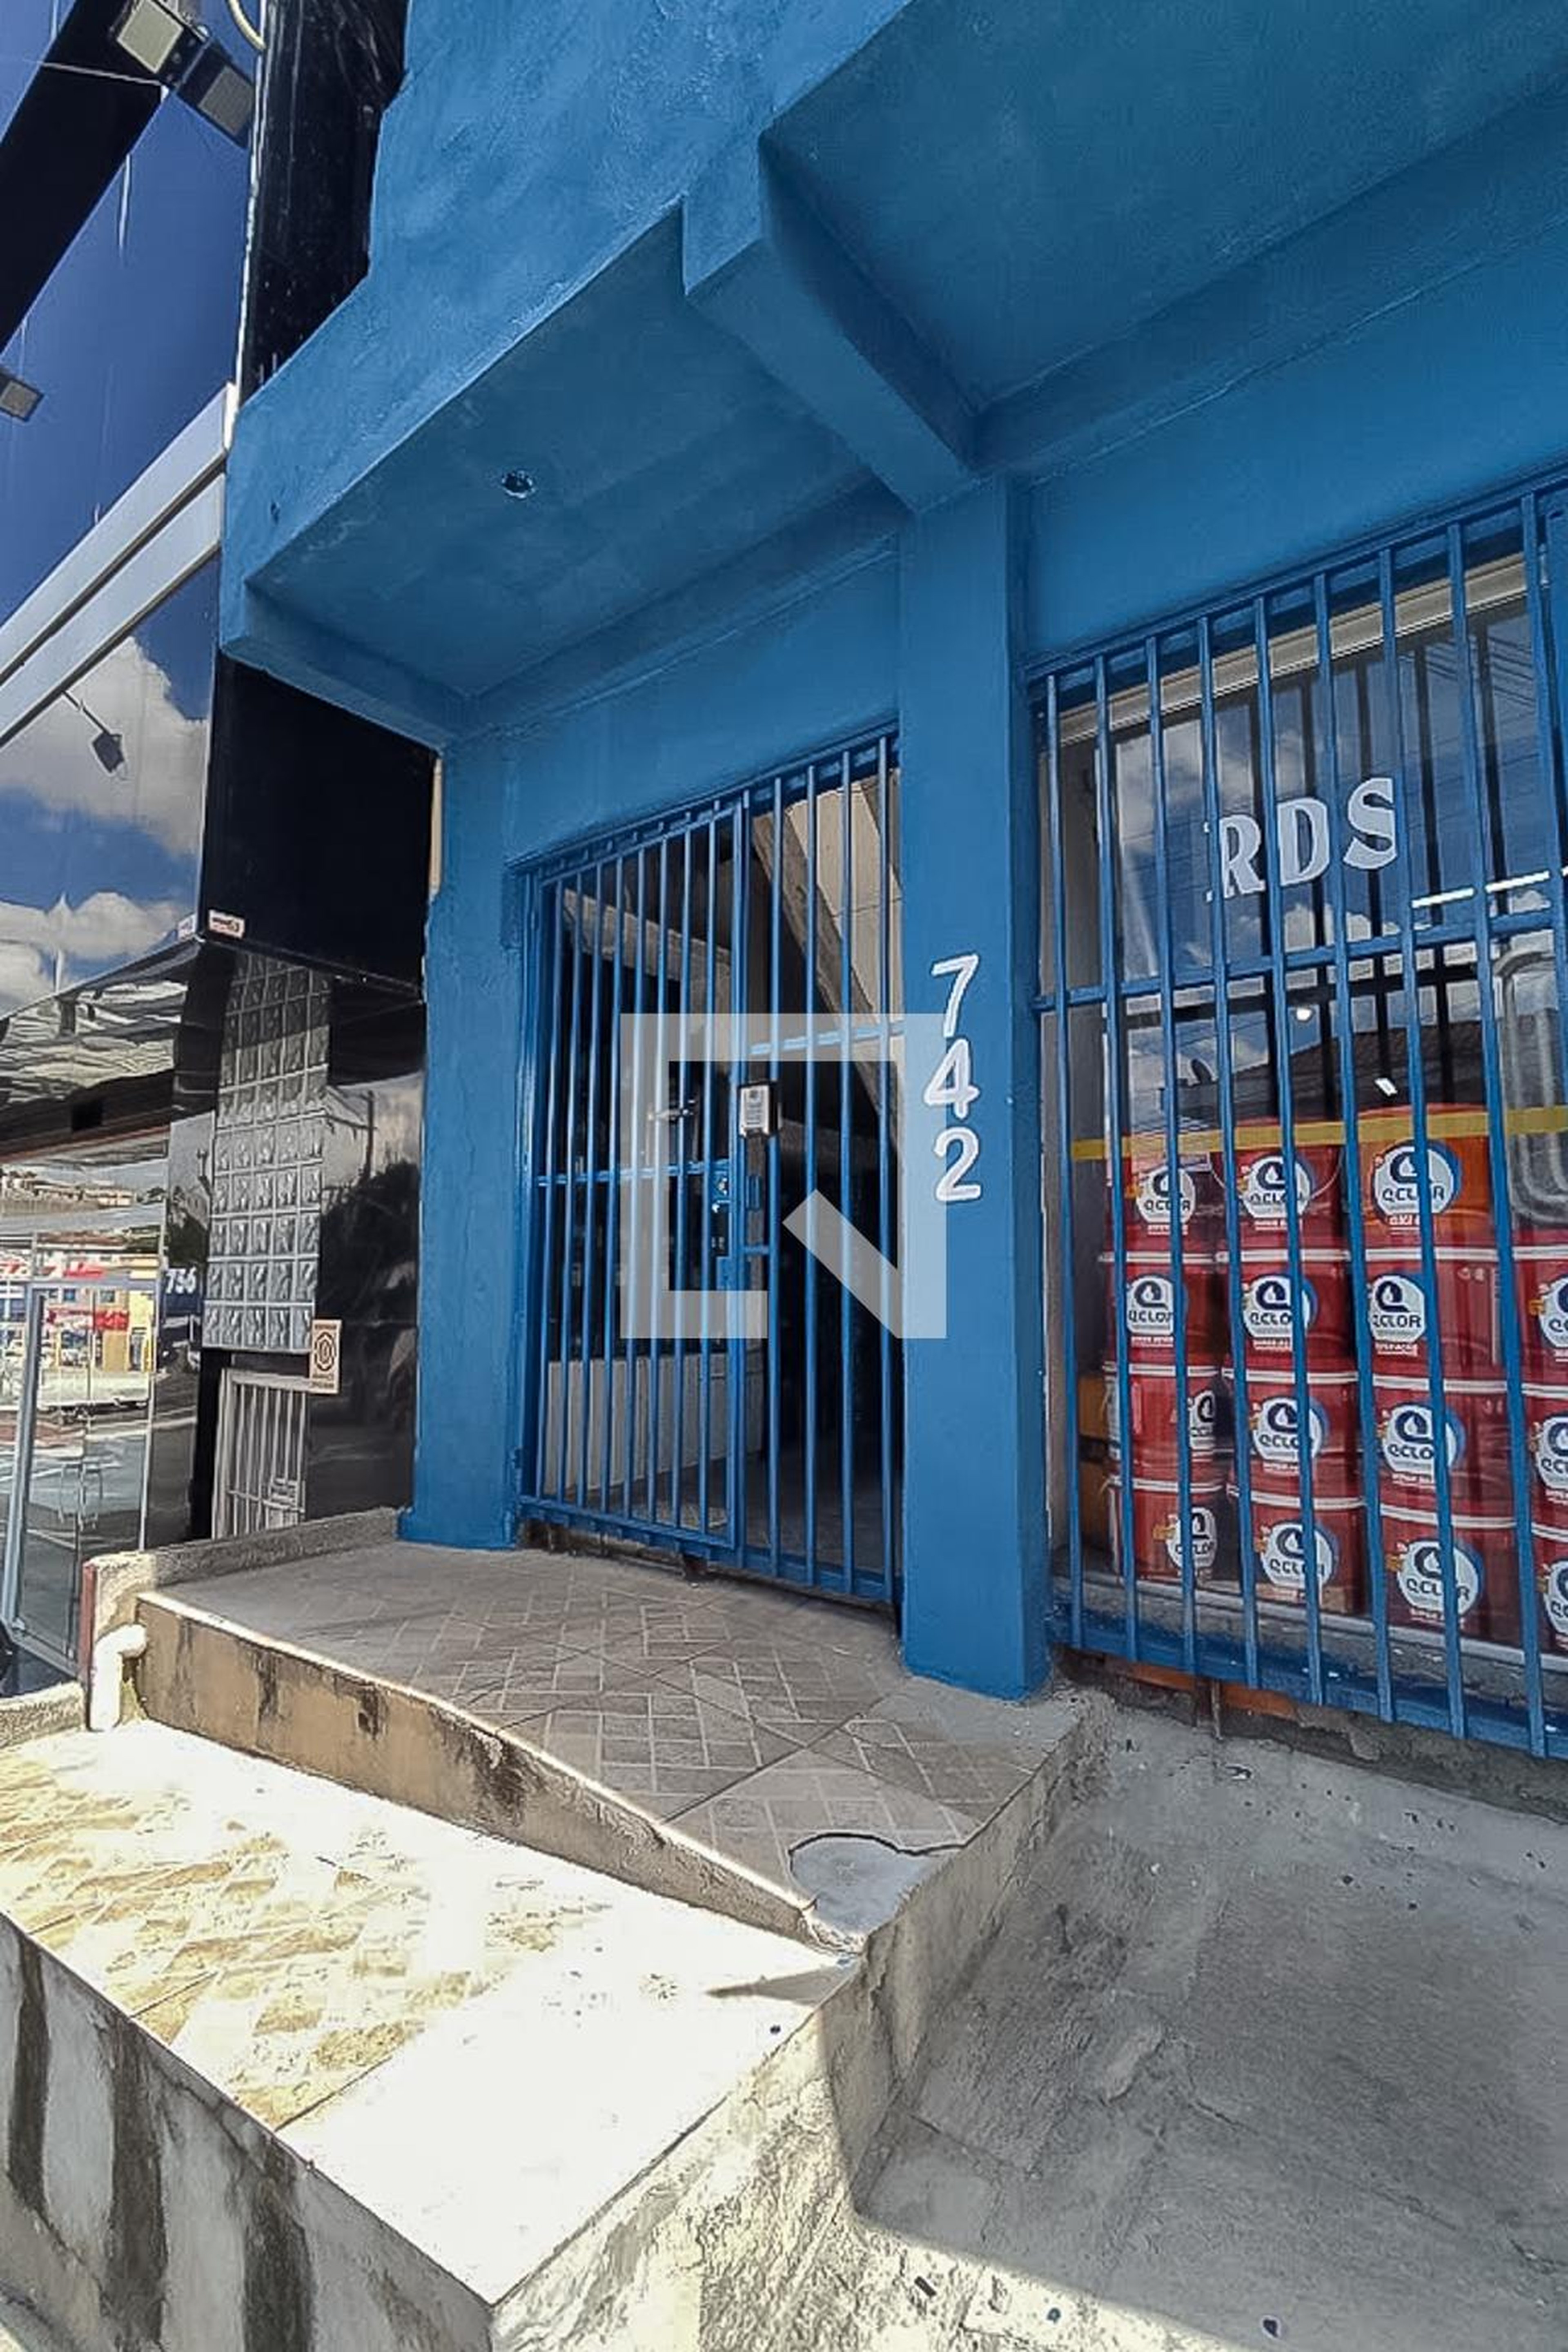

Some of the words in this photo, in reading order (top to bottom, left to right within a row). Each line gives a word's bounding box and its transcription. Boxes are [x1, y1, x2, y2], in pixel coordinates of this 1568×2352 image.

[1204, 777, 1397, 900] RDS
[923, 953, 981, 1202] 742
[1382, 1185, 1444, 1202] QCLR
[1250, 1312, 1292, 1325] QCLO
[1388, 1444, 1435, 1459] QCLO
